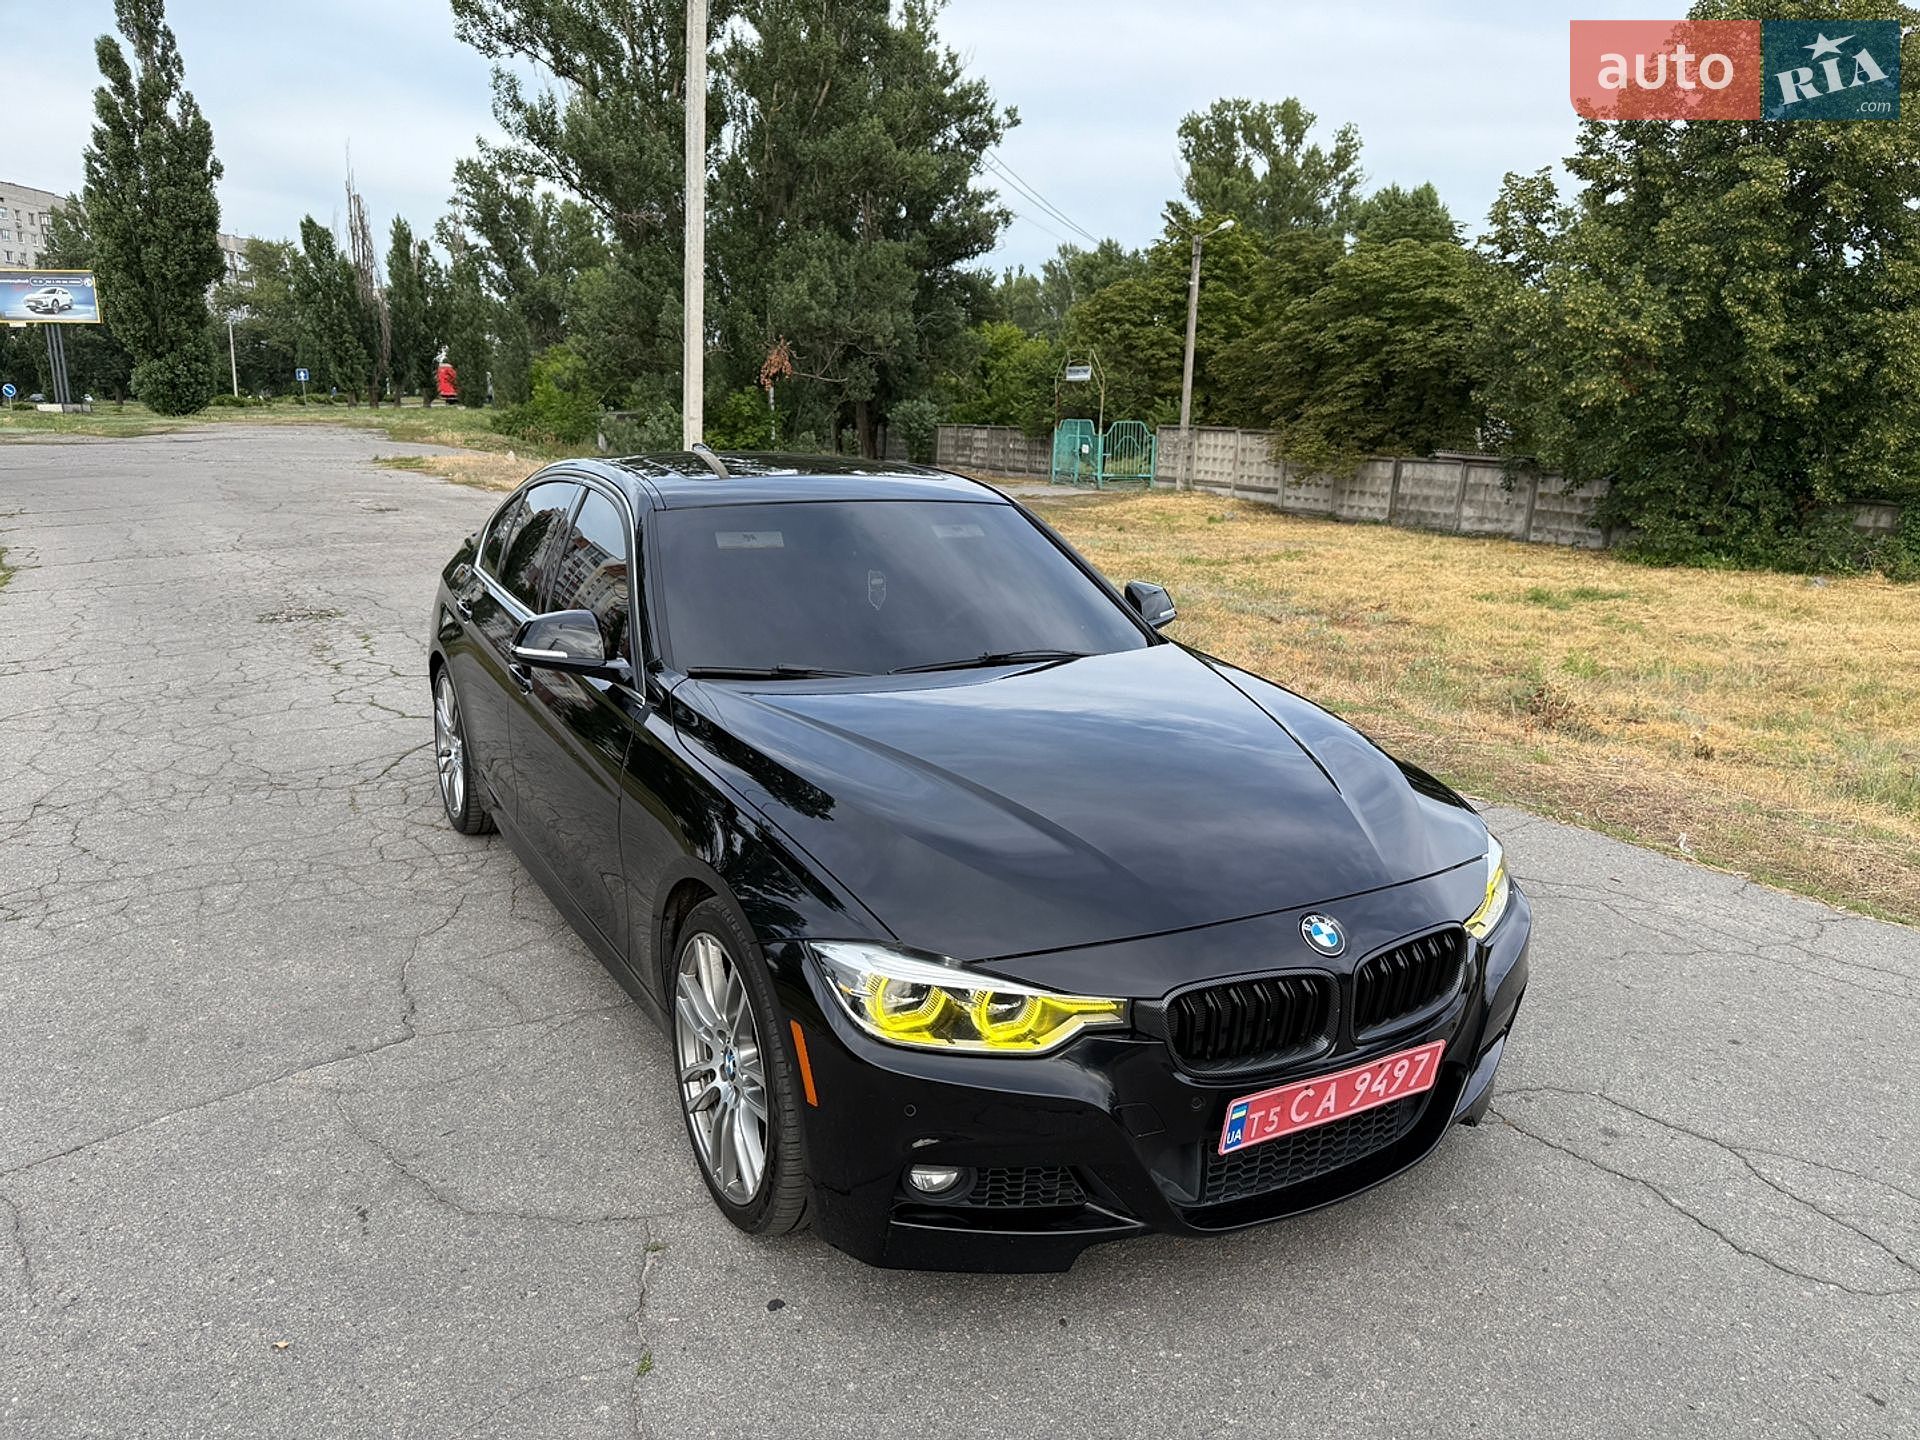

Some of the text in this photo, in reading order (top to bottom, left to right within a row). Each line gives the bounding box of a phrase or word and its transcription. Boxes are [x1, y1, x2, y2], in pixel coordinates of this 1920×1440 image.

[1249, 1052, 1430, 1138] T5 CA 9497
[1226, 1129, 1242, 1144] UA
